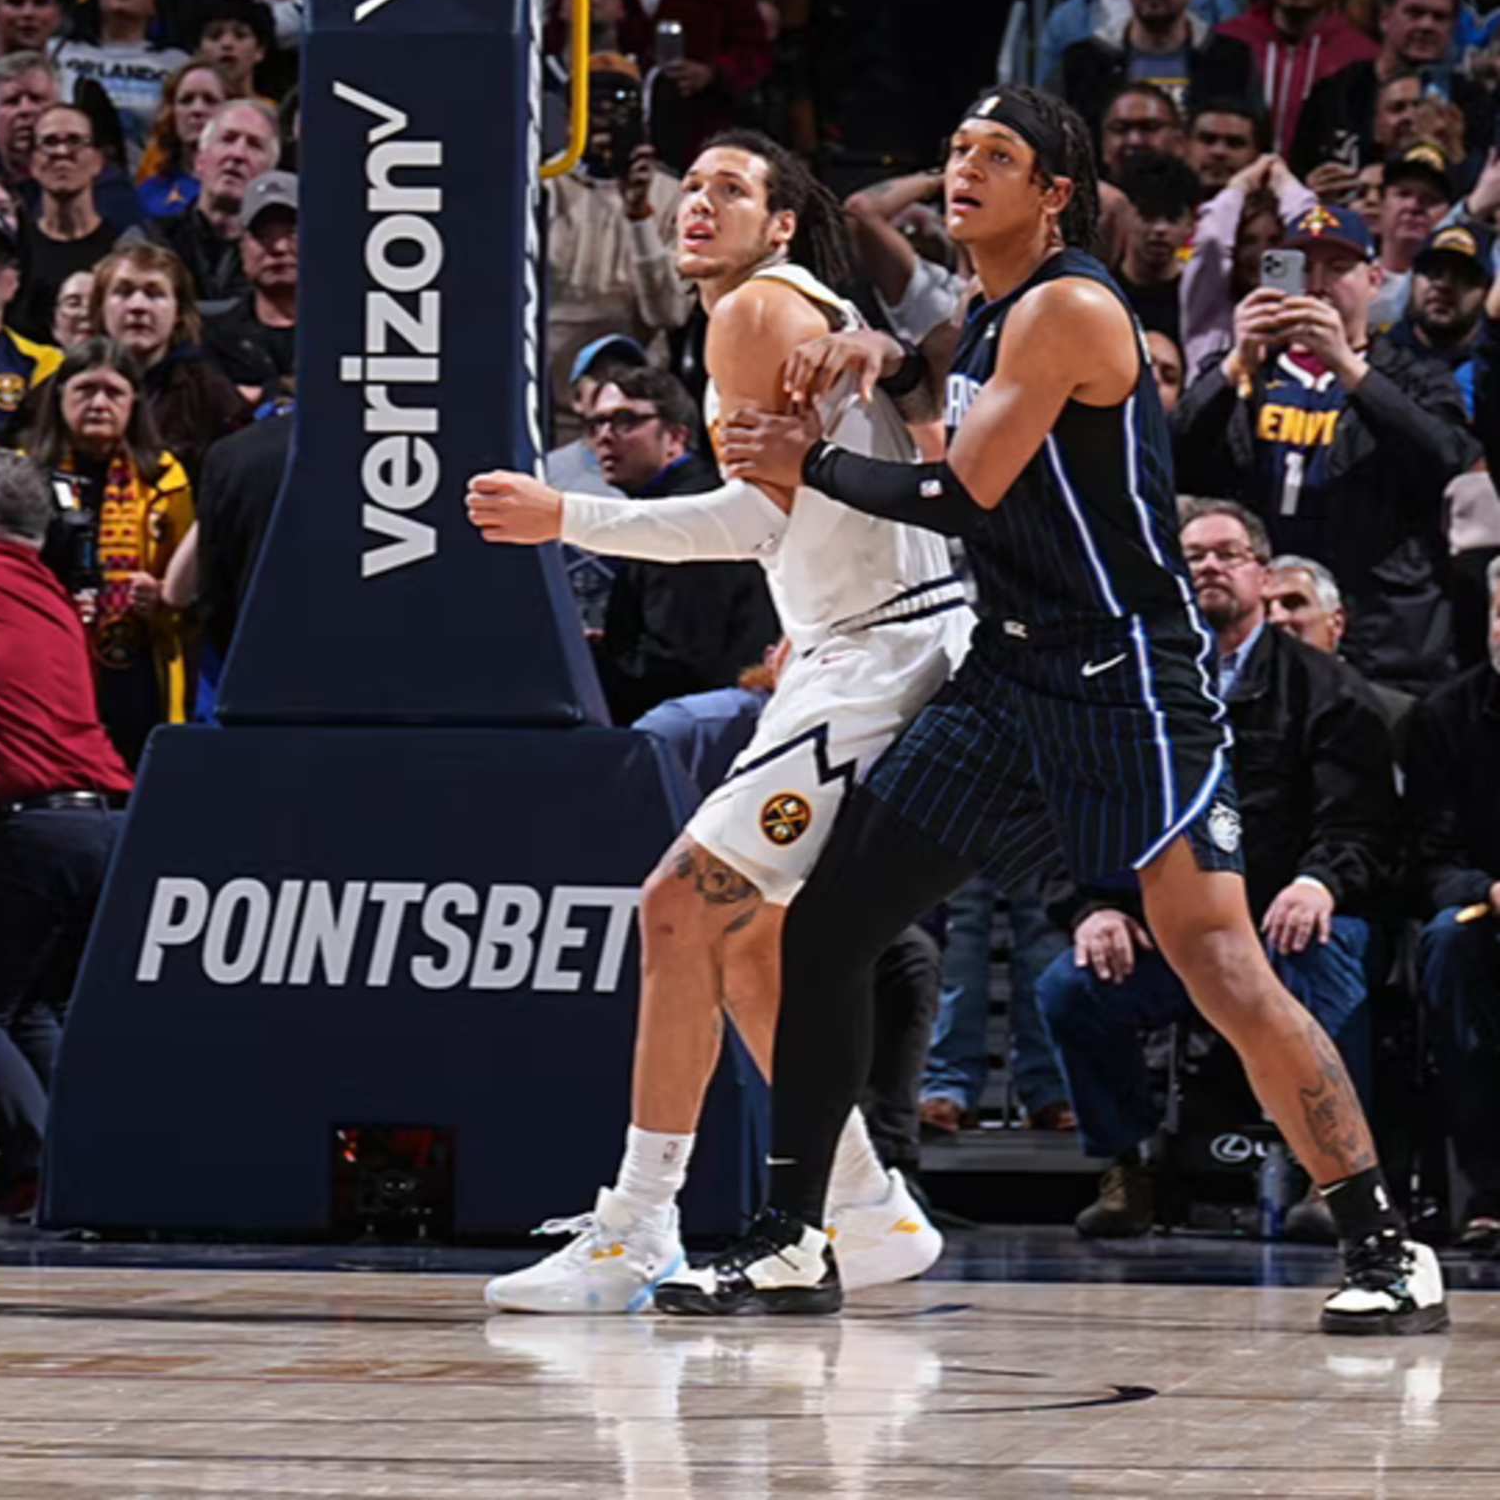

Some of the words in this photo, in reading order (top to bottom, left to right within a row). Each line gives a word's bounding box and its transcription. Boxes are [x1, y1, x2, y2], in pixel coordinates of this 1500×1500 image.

[340, 140, 444, 578] verizon
[1280, 451, 1304, 517] 1
[136, 877, 643, 993] POINTSBET
